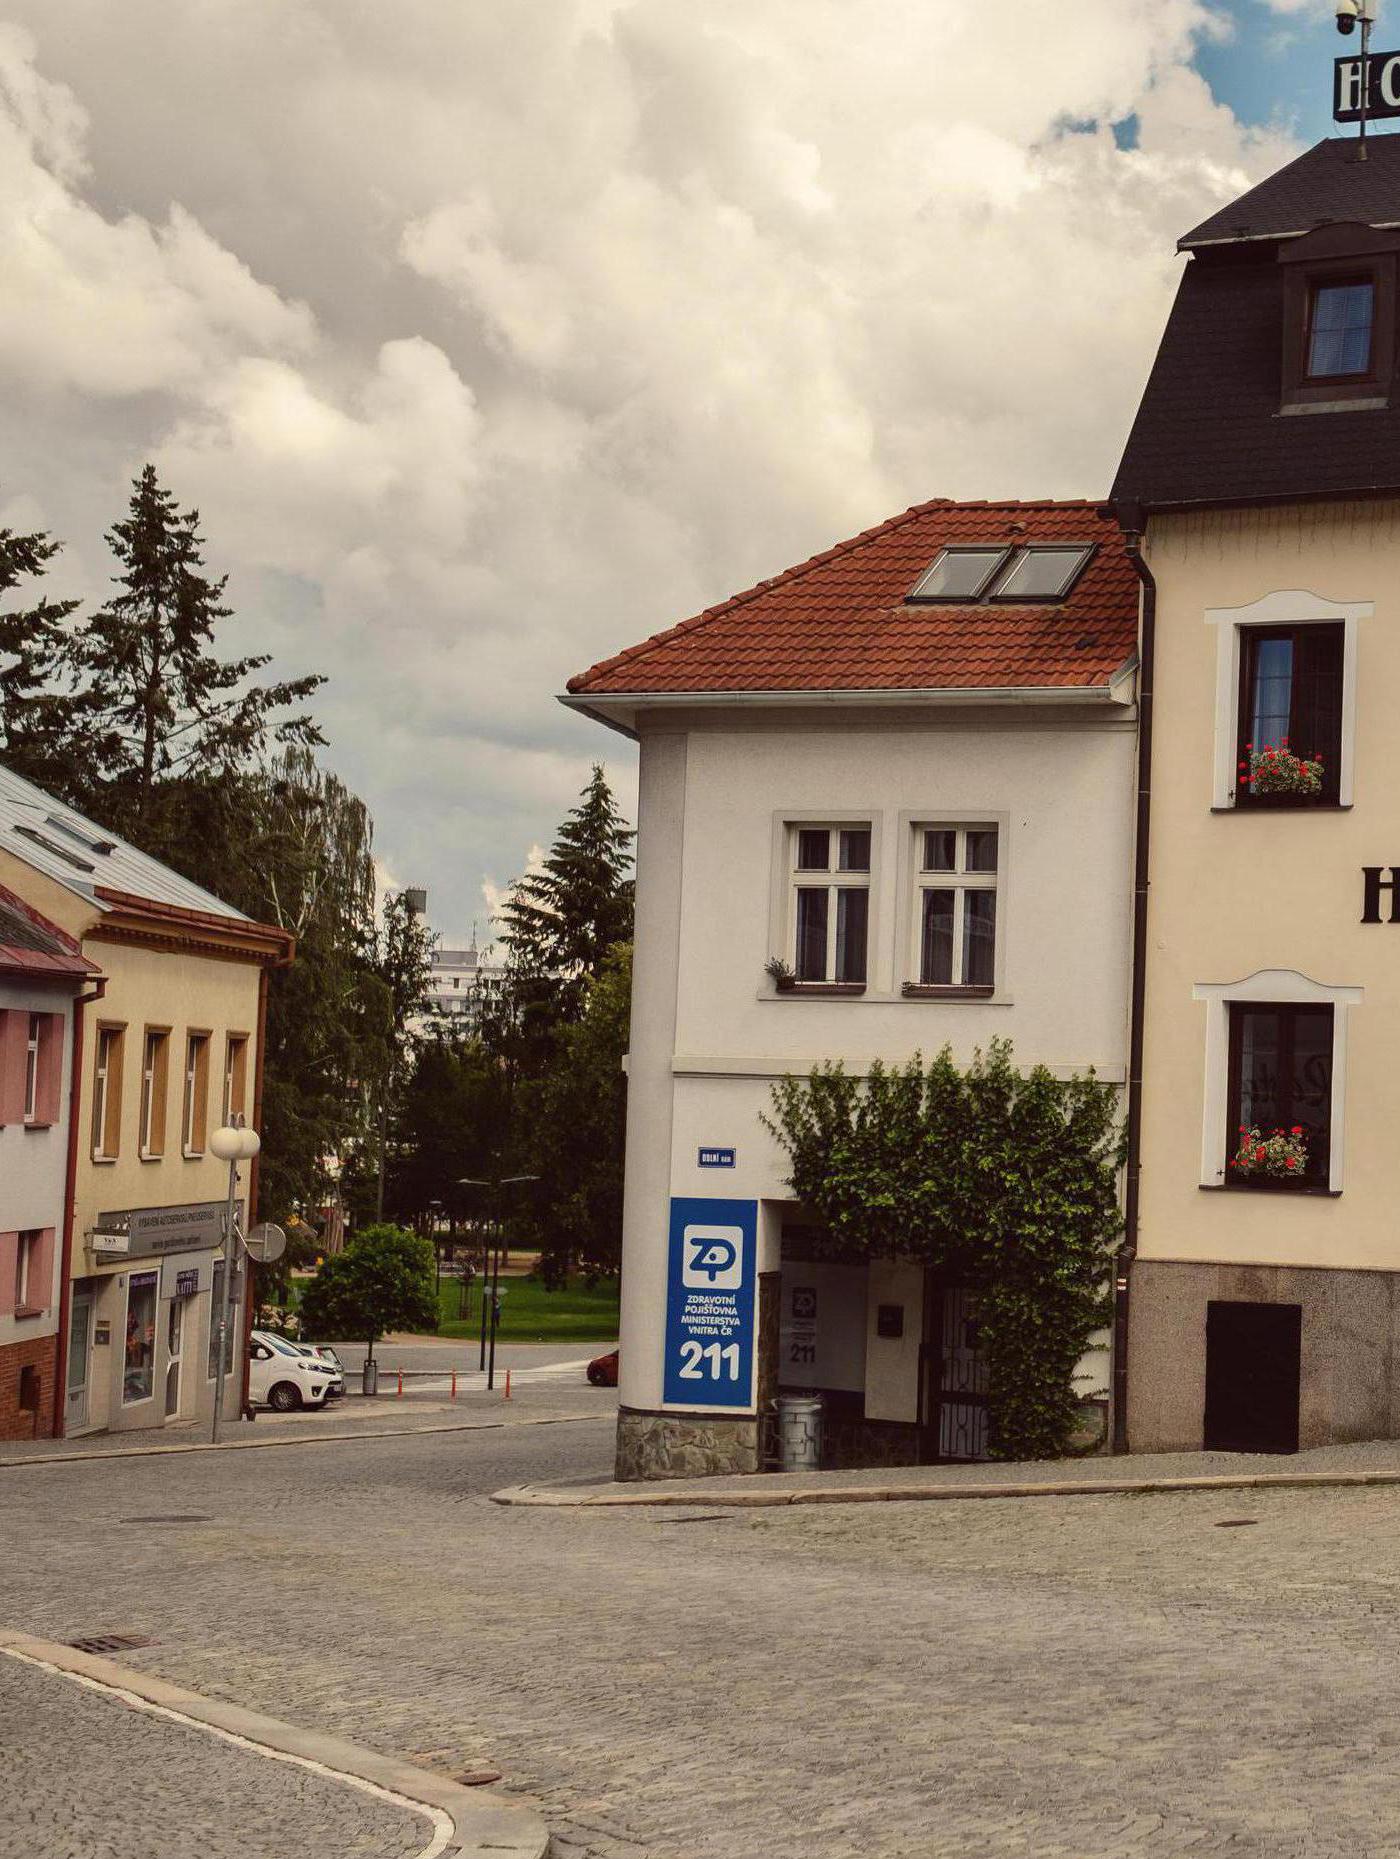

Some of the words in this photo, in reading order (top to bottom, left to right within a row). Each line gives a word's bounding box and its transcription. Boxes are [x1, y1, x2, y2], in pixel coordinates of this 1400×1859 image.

[687, 1294, 736, 1305] ZDRAVOTNÍ
[685, 1303, 738, 1316] POJIŠŤOVNA
[681, 1315, 741, 1327] MINISTERSTVA
[688, 1325, 719, 1335] VNITRA
[720, 1323, 733, 1336] ČR
[791, 1344, 816, 1363] 211
[679, 1340, 740, 1381] 211
